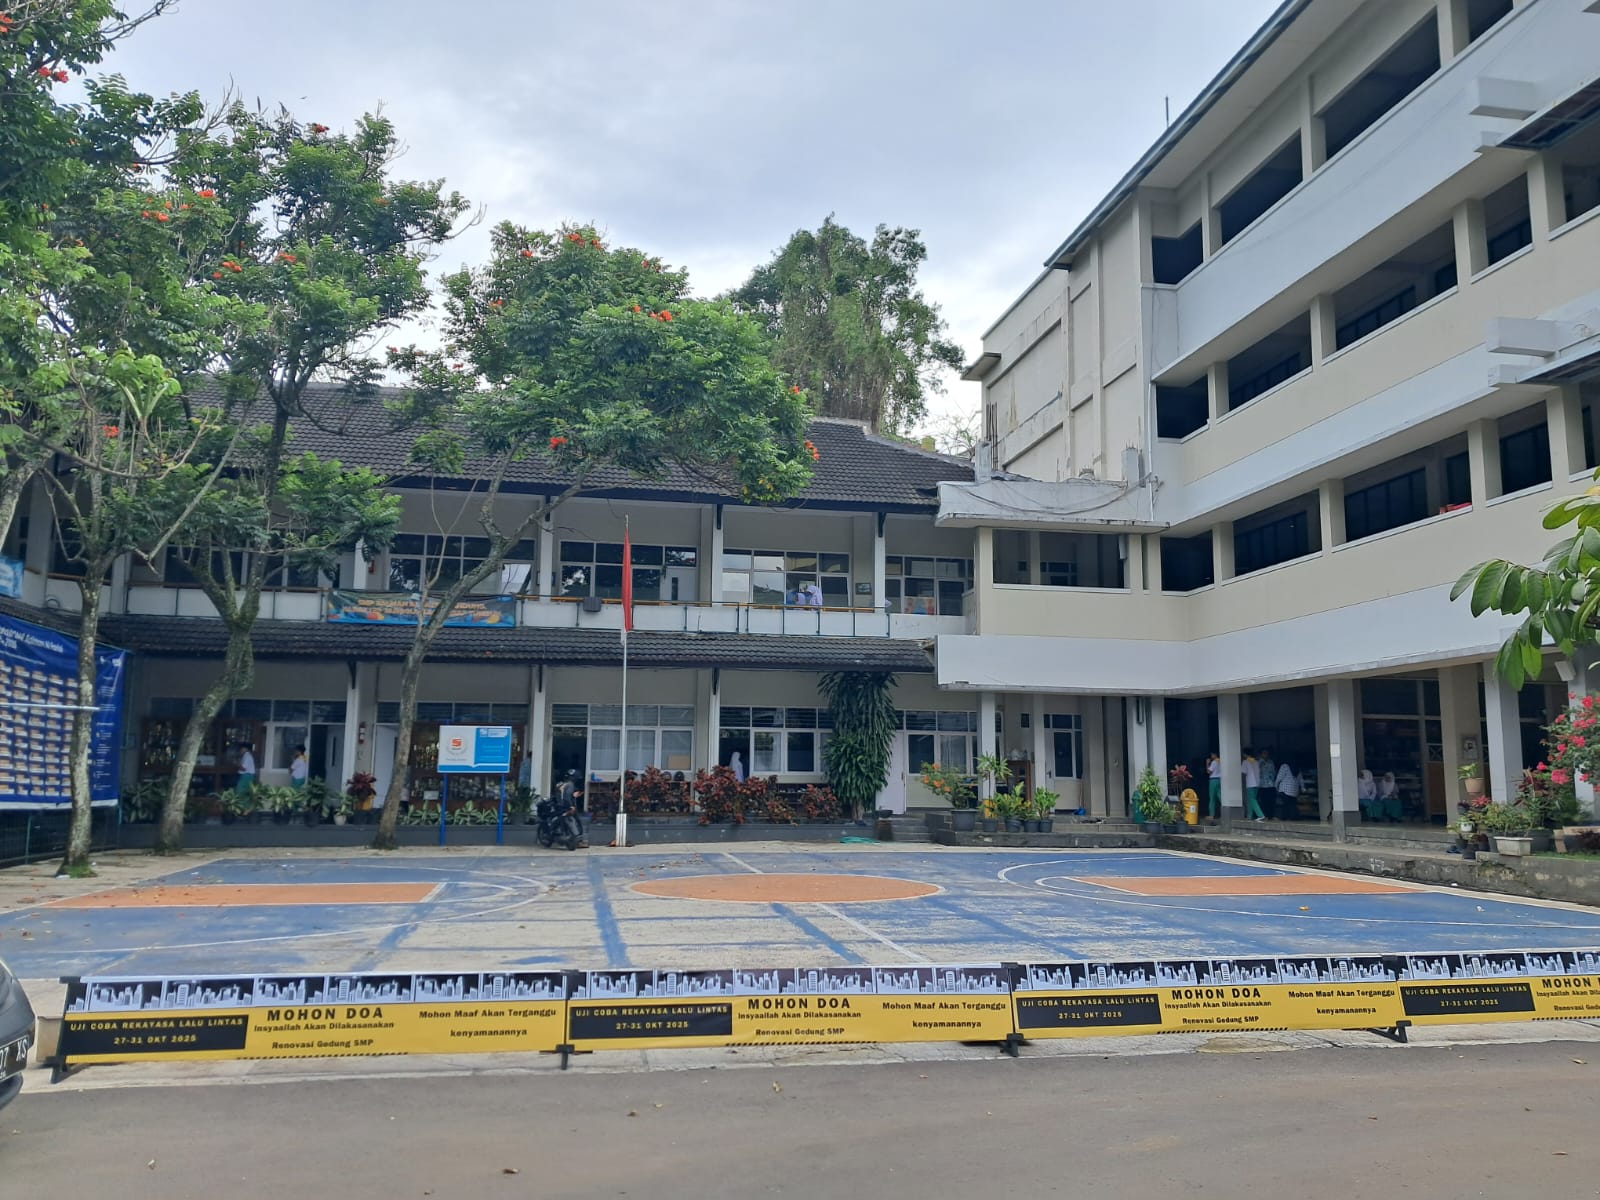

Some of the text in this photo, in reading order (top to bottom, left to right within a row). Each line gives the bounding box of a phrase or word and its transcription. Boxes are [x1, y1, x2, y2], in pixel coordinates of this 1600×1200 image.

[1541, 977, 1592, 988] MOHON
[1171, 987, 1261, 1000] MOHON DOA
[1356, 989, 1395, 998] Terganggu
[1502, 985, 1528, 993] LINTAS
[748, 997, 851, 1010] MOHON DOA
[962, 1002, 1006, 1010] Terganggu
[267, 1007, 383, 1021] MOHON DOA
[419, 1008, 556, 1018] Mohon Maaf Akan Terganggu
[697, 1006, 728, 1014] LINTAS
[1316, 1007, 1377, 1015] kenyamanannya
[70, 1018, 243, 1031] UJI COBA REKAYASA LALU LINTAS
[912, 1020, 982, 1029] kenyamanannya
[1216, 1016, 1242, 1024] Gedung
[304, 1023, 326, 1031] Akan
[329, 1021, 394, 1030] Dilakasanakan
[615, 1021, 688, 1030] 27-31 OKT 2025
[450, 1028, 528, 1038] kenyamanannya
[755, 1028, 792, 1036] Renovasi
[794, 1028, 825, 1036] Gedung
[114, 1034, 197, 1045] 27-31 OKT 2025
[272, 1040, 314, 1049] Renovasi
[317, 1040, 351, 1048] Gedung
